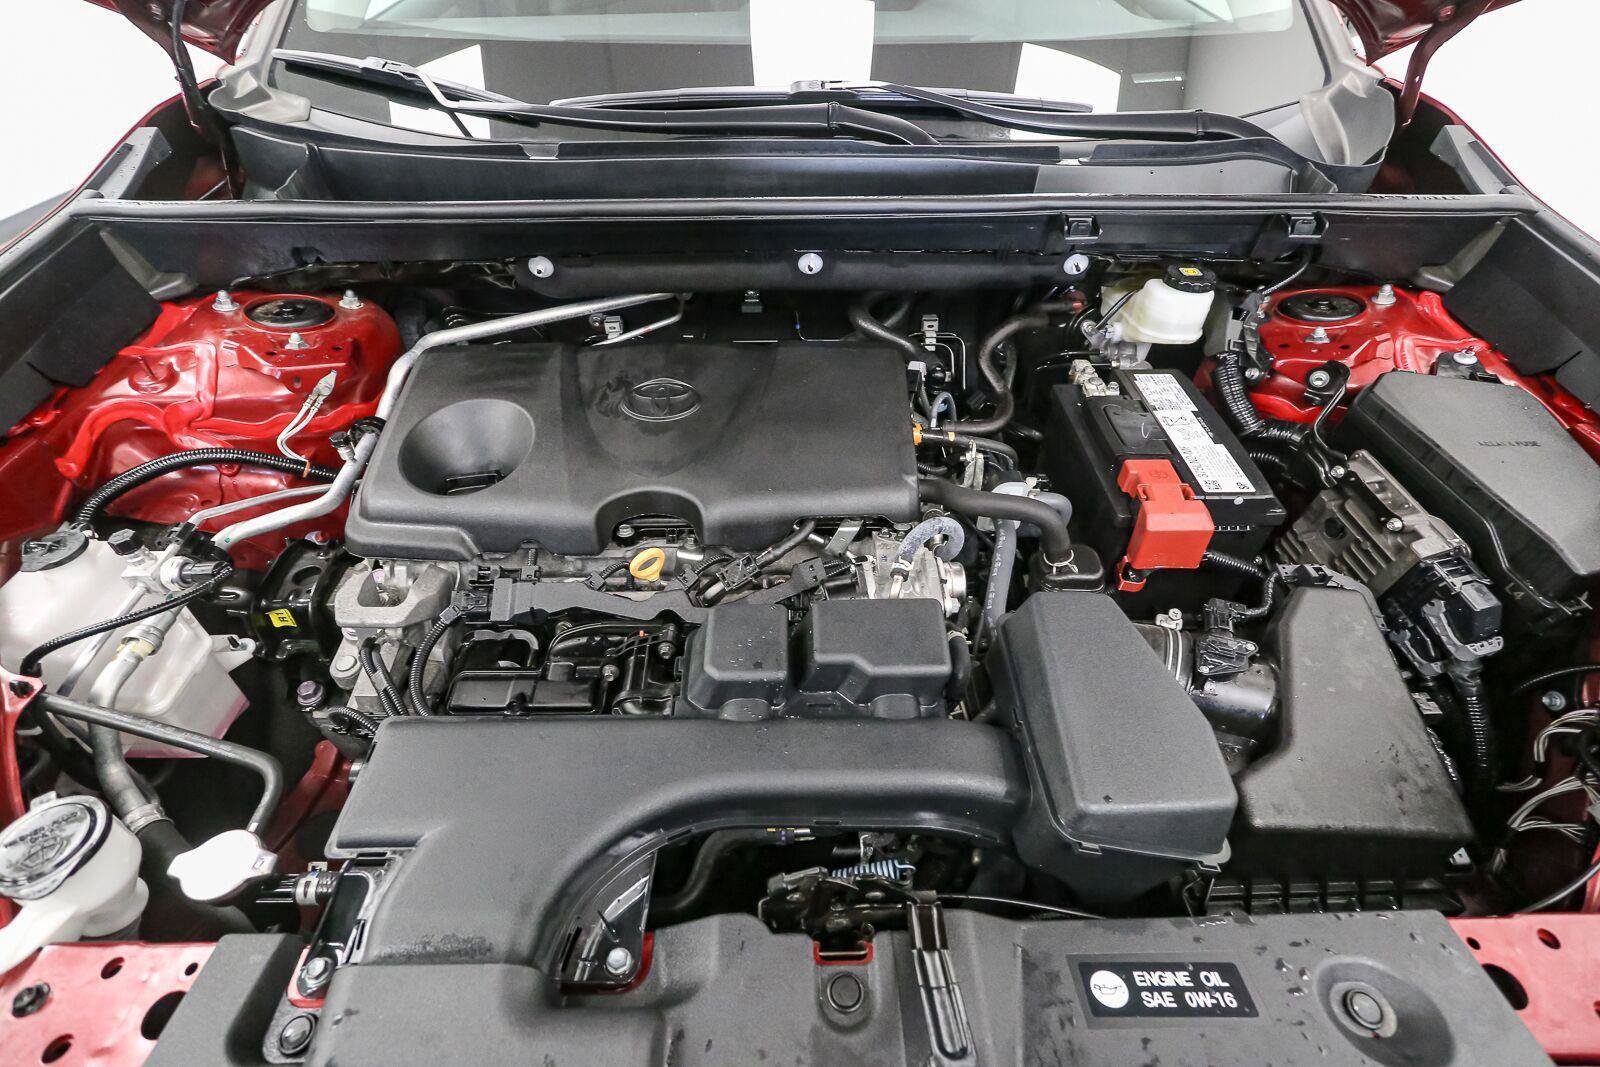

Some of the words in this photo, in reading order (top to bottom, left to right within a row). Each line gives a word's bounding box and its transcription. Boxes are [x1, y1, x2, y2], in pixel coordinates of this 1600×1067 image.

[1132, 970, 1194, 987] ENGINE
[1199, 970, 1231, 987] OIL
[1140, 991, 1178, 1008] SAE
[1184, 991, 1238, 1009] 0W-16
